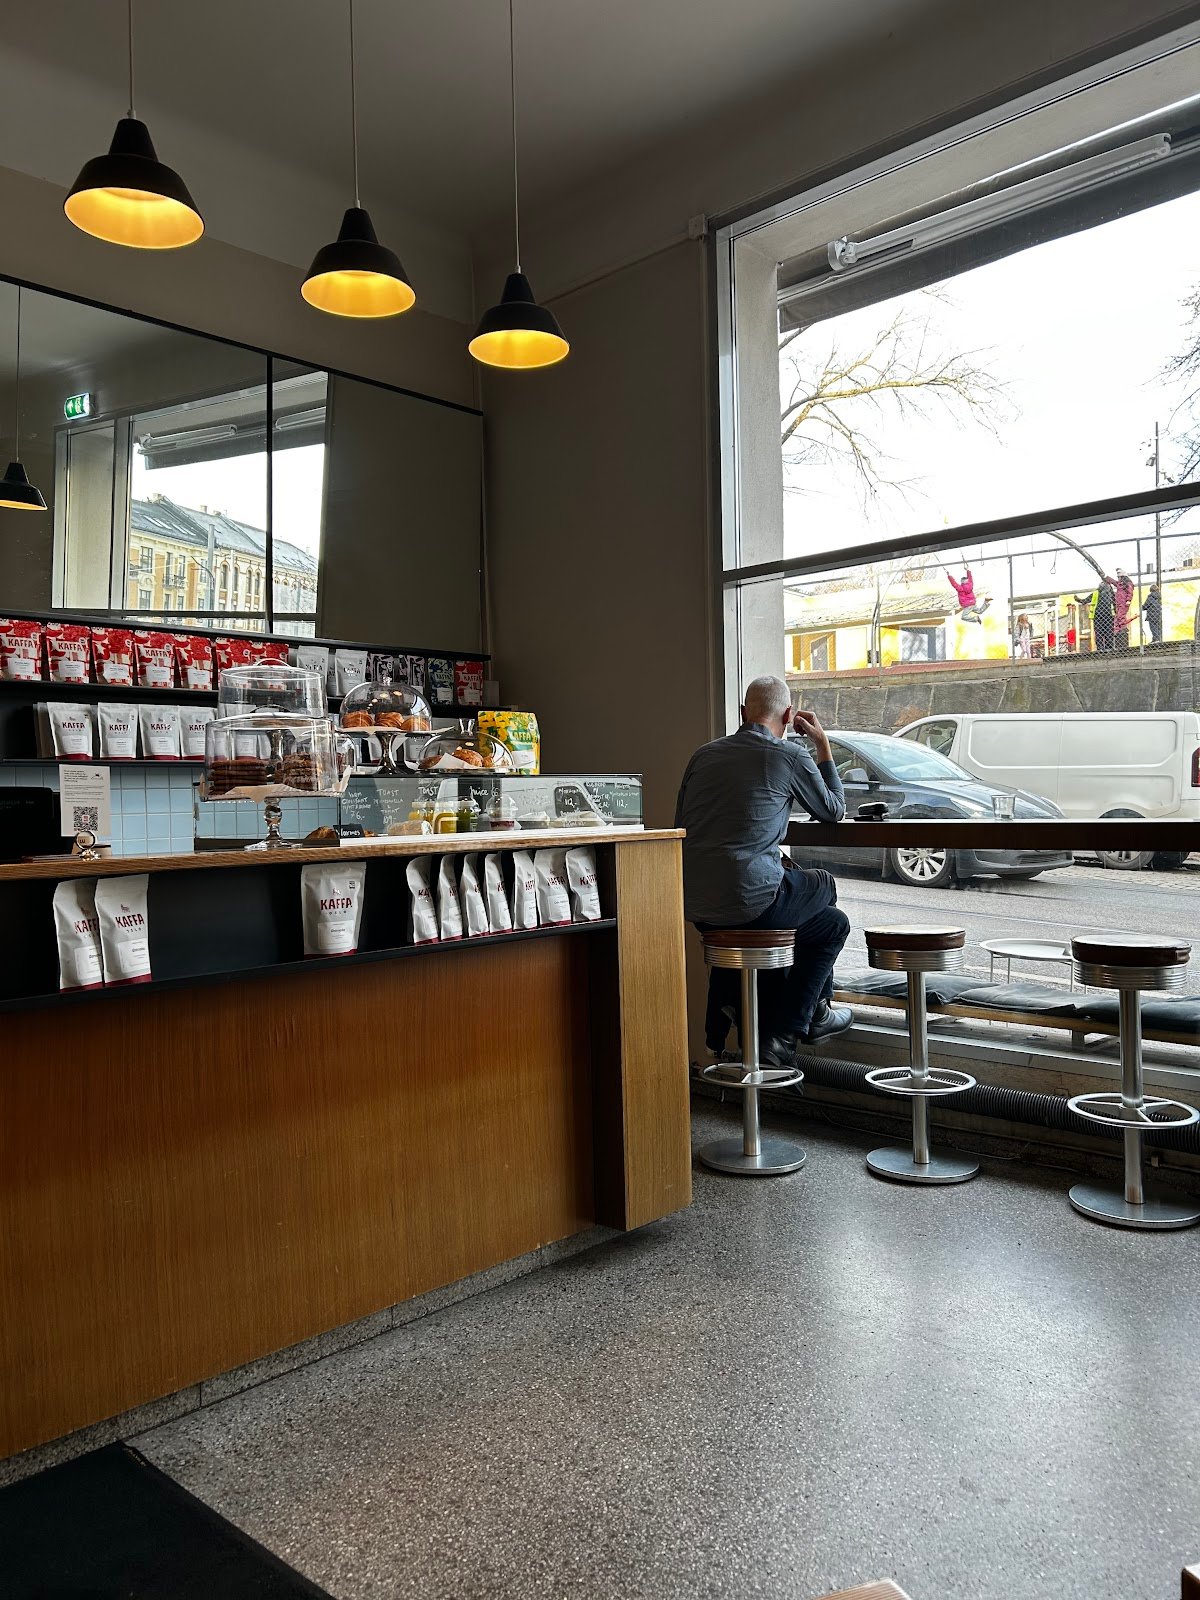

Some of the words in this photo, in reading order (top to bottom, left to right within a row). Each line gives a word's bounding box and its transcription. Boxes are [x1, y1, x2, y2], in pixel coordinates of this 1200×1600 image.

[8, 638, 34, 648] KAFFA
[320, 897, 353, 910] KAFFA
[115, 913, 145, 928] KAFFA
